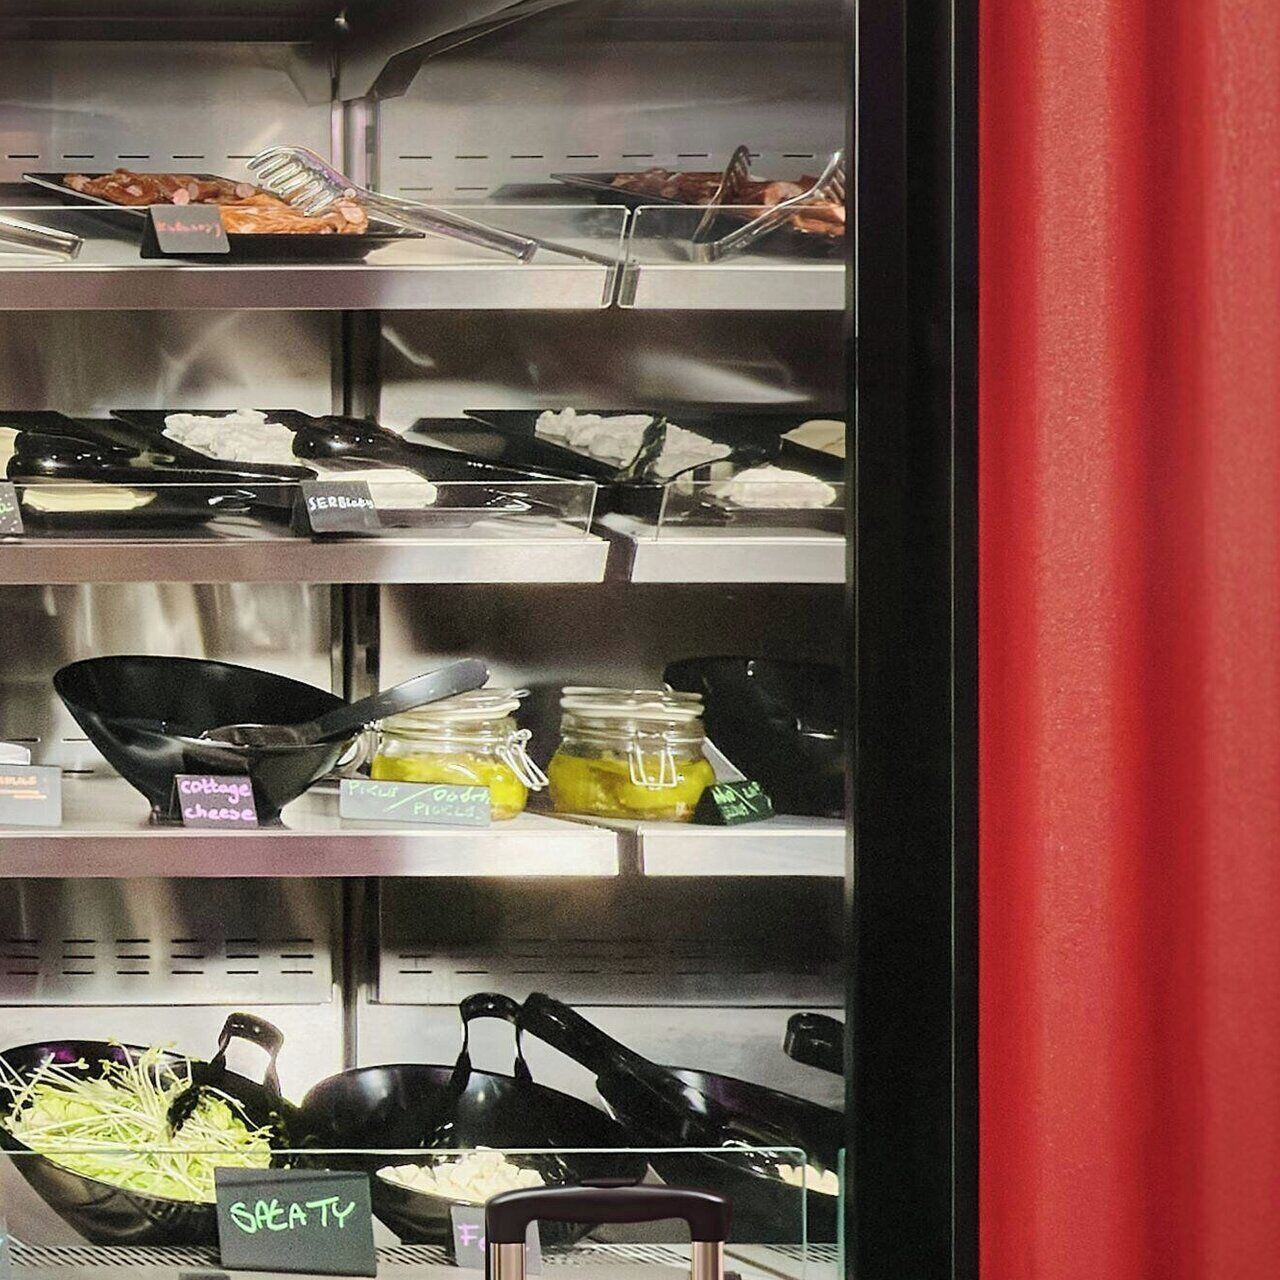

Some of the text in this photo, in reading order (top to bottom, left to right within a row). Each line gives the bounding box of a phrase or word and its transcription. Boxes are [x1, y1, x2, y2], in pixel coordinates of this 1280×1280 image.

[180, 778, 252, 805] cottage
[184, 803, 258, 820] cheese
[229, 1195, 356, 1234] SAŁATY
